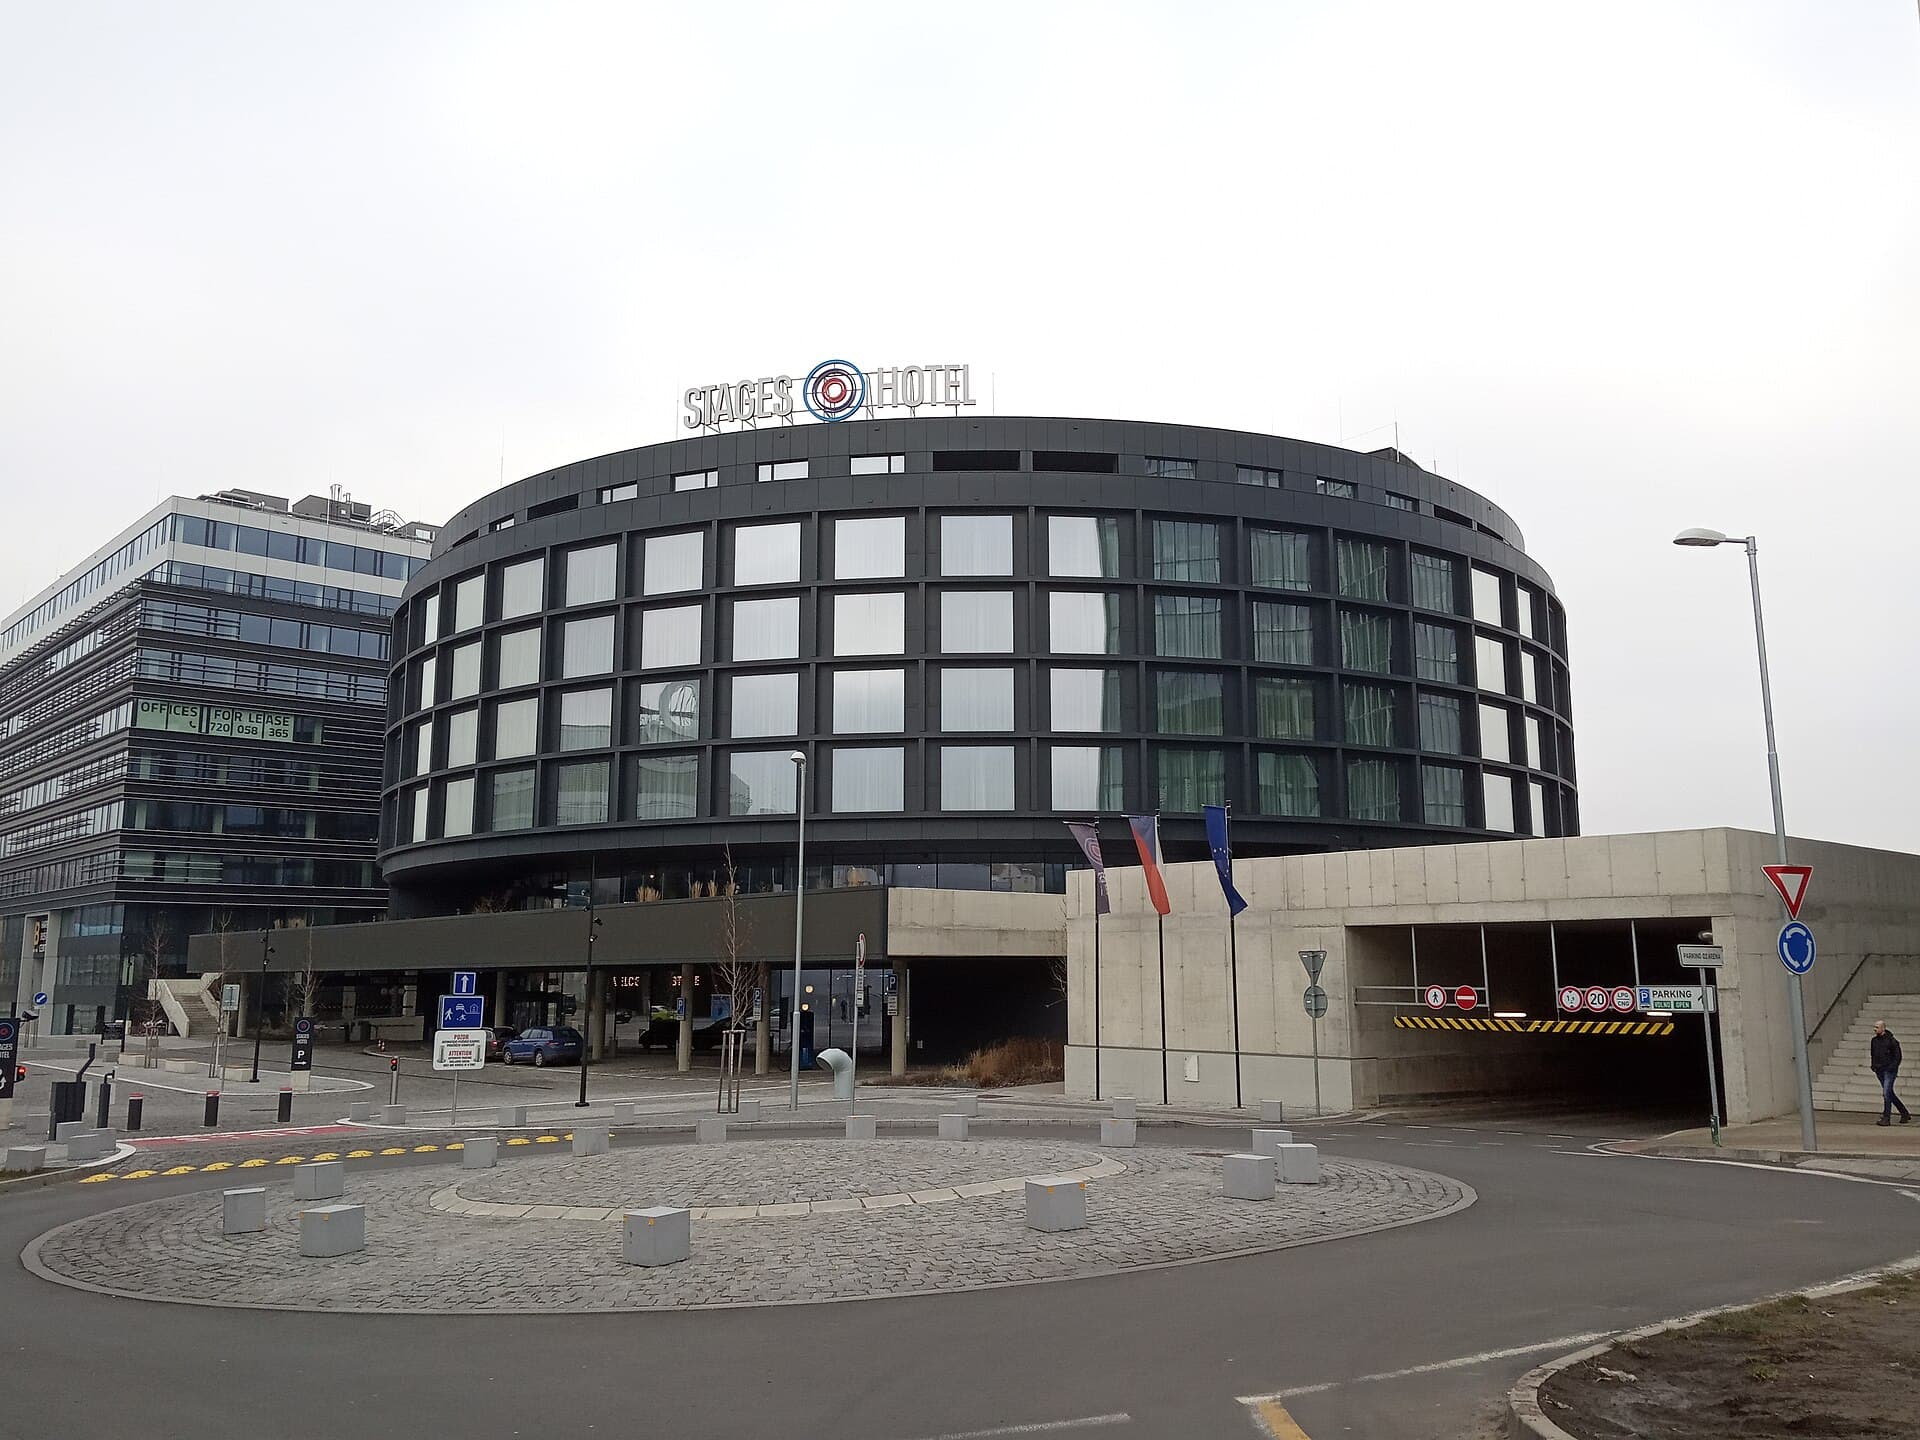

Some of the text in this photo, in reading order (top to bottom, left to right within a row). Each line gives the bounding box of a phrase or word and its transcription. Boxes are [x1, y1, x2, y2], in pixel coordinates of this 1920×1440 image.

[684, 364, 976, 428] STAGES HOTEL
[140, 702, 290, 726] OFFICES FOR LEASE
[210, 721, 289, 738] 720 058 365
[1590, 993, 1605, 1005] 20
[1641, 990, 1692, 1001] P PARKING
[298, 1050, 304, 1058] P
